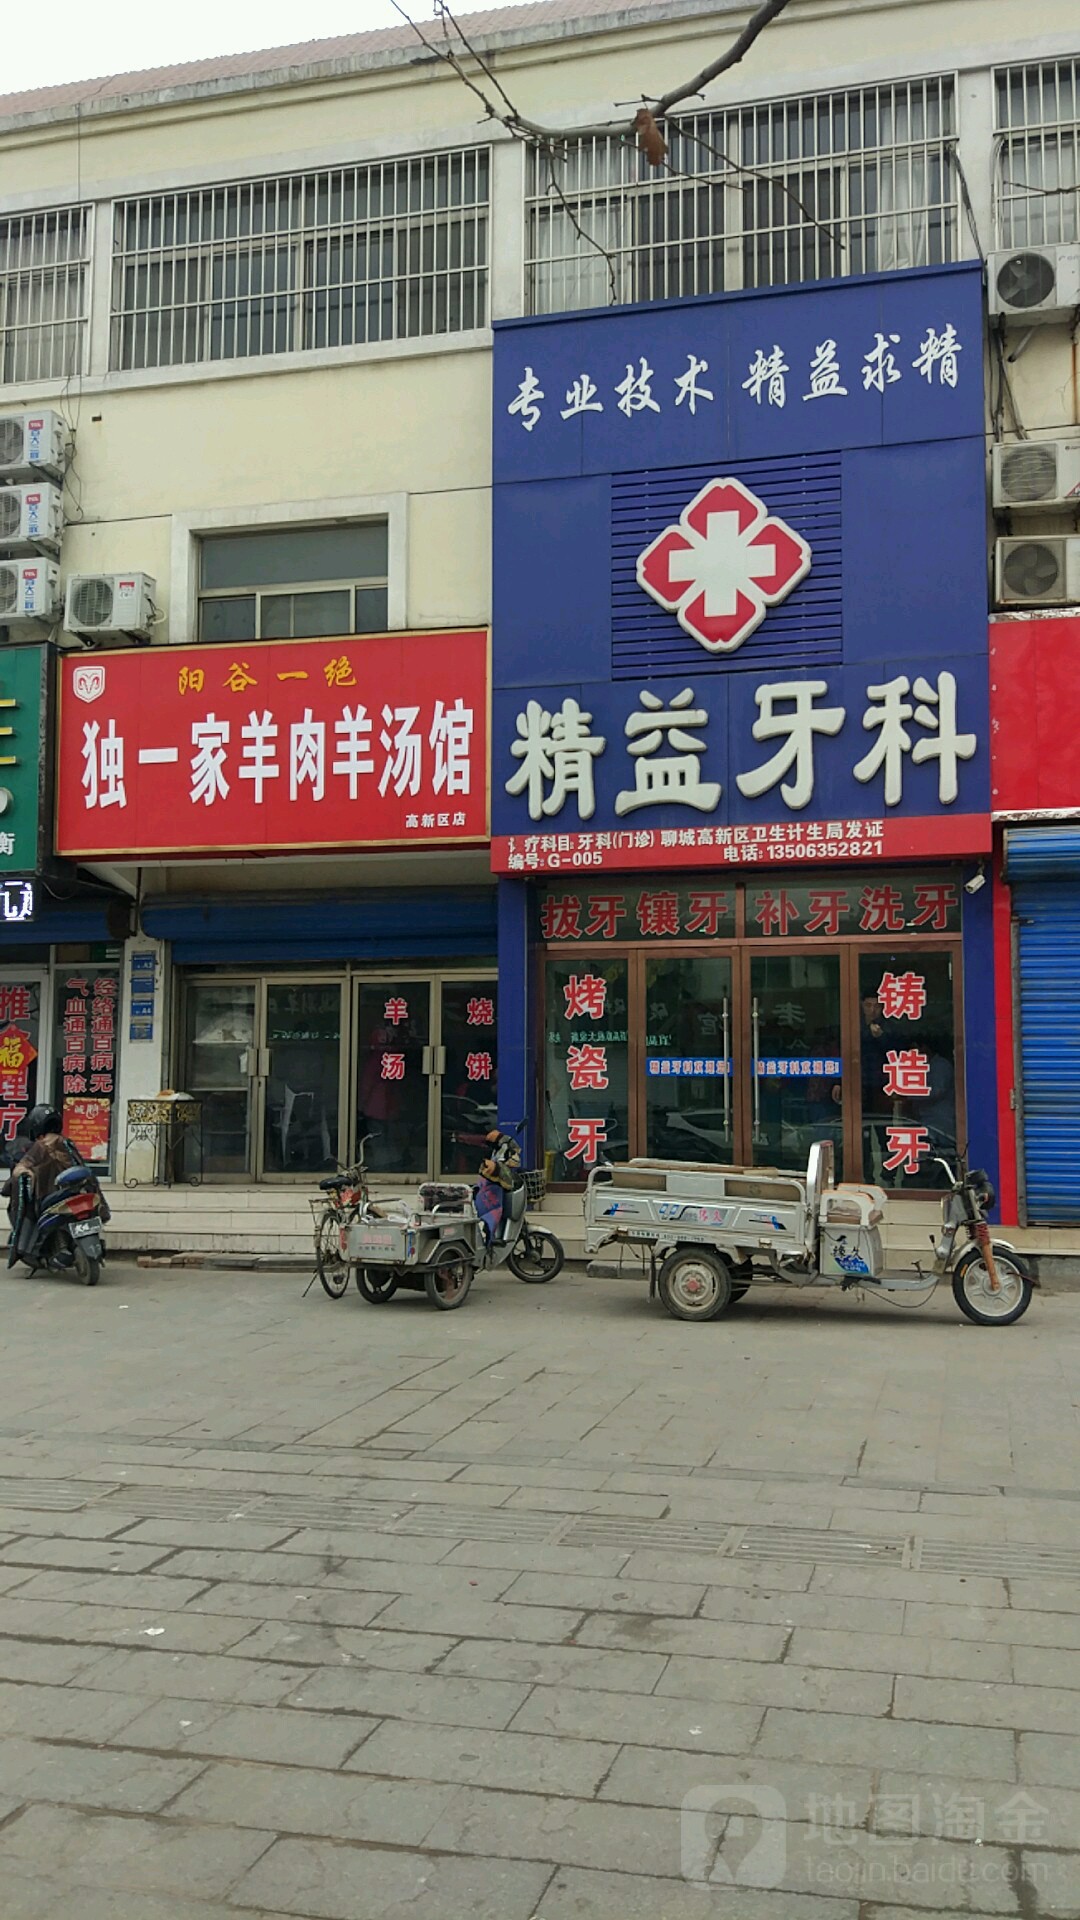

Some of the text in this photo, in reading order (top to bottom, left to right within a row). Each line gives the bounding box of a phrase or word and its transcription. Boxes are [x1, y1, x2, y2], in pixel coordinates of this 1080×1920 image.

[507, 323, 963, 431] 专业技术 精益求精
[177, 656, 357, 695] 阳谷一绝
[80, 698, 474, 809] 独一家羊肉羊汤馆
[504, 670, 977, 820] 精益牙科
[405, 811, 467, 829] 高新区店
[660, 821, 884, 846] 聊城高新区卫生计生局发证
[723, 840, 883, 862] 电话:13506352821
[541, 883, 958, 939] 拔牙镶牙 补牙洗牙
[0, 1036, 24, 1068] 福
[63, 978, 89, 1094] 气血通百病除
[90, 978, 117, 1093] 经络通百病无
[381, 998, 408, 1080] 羊汤
[465, 998, 494, 1080] 烧饼
[563, 973, 609, 1164] 烤瓷牙
[877, 971, 931, 1174] 铸造牙
